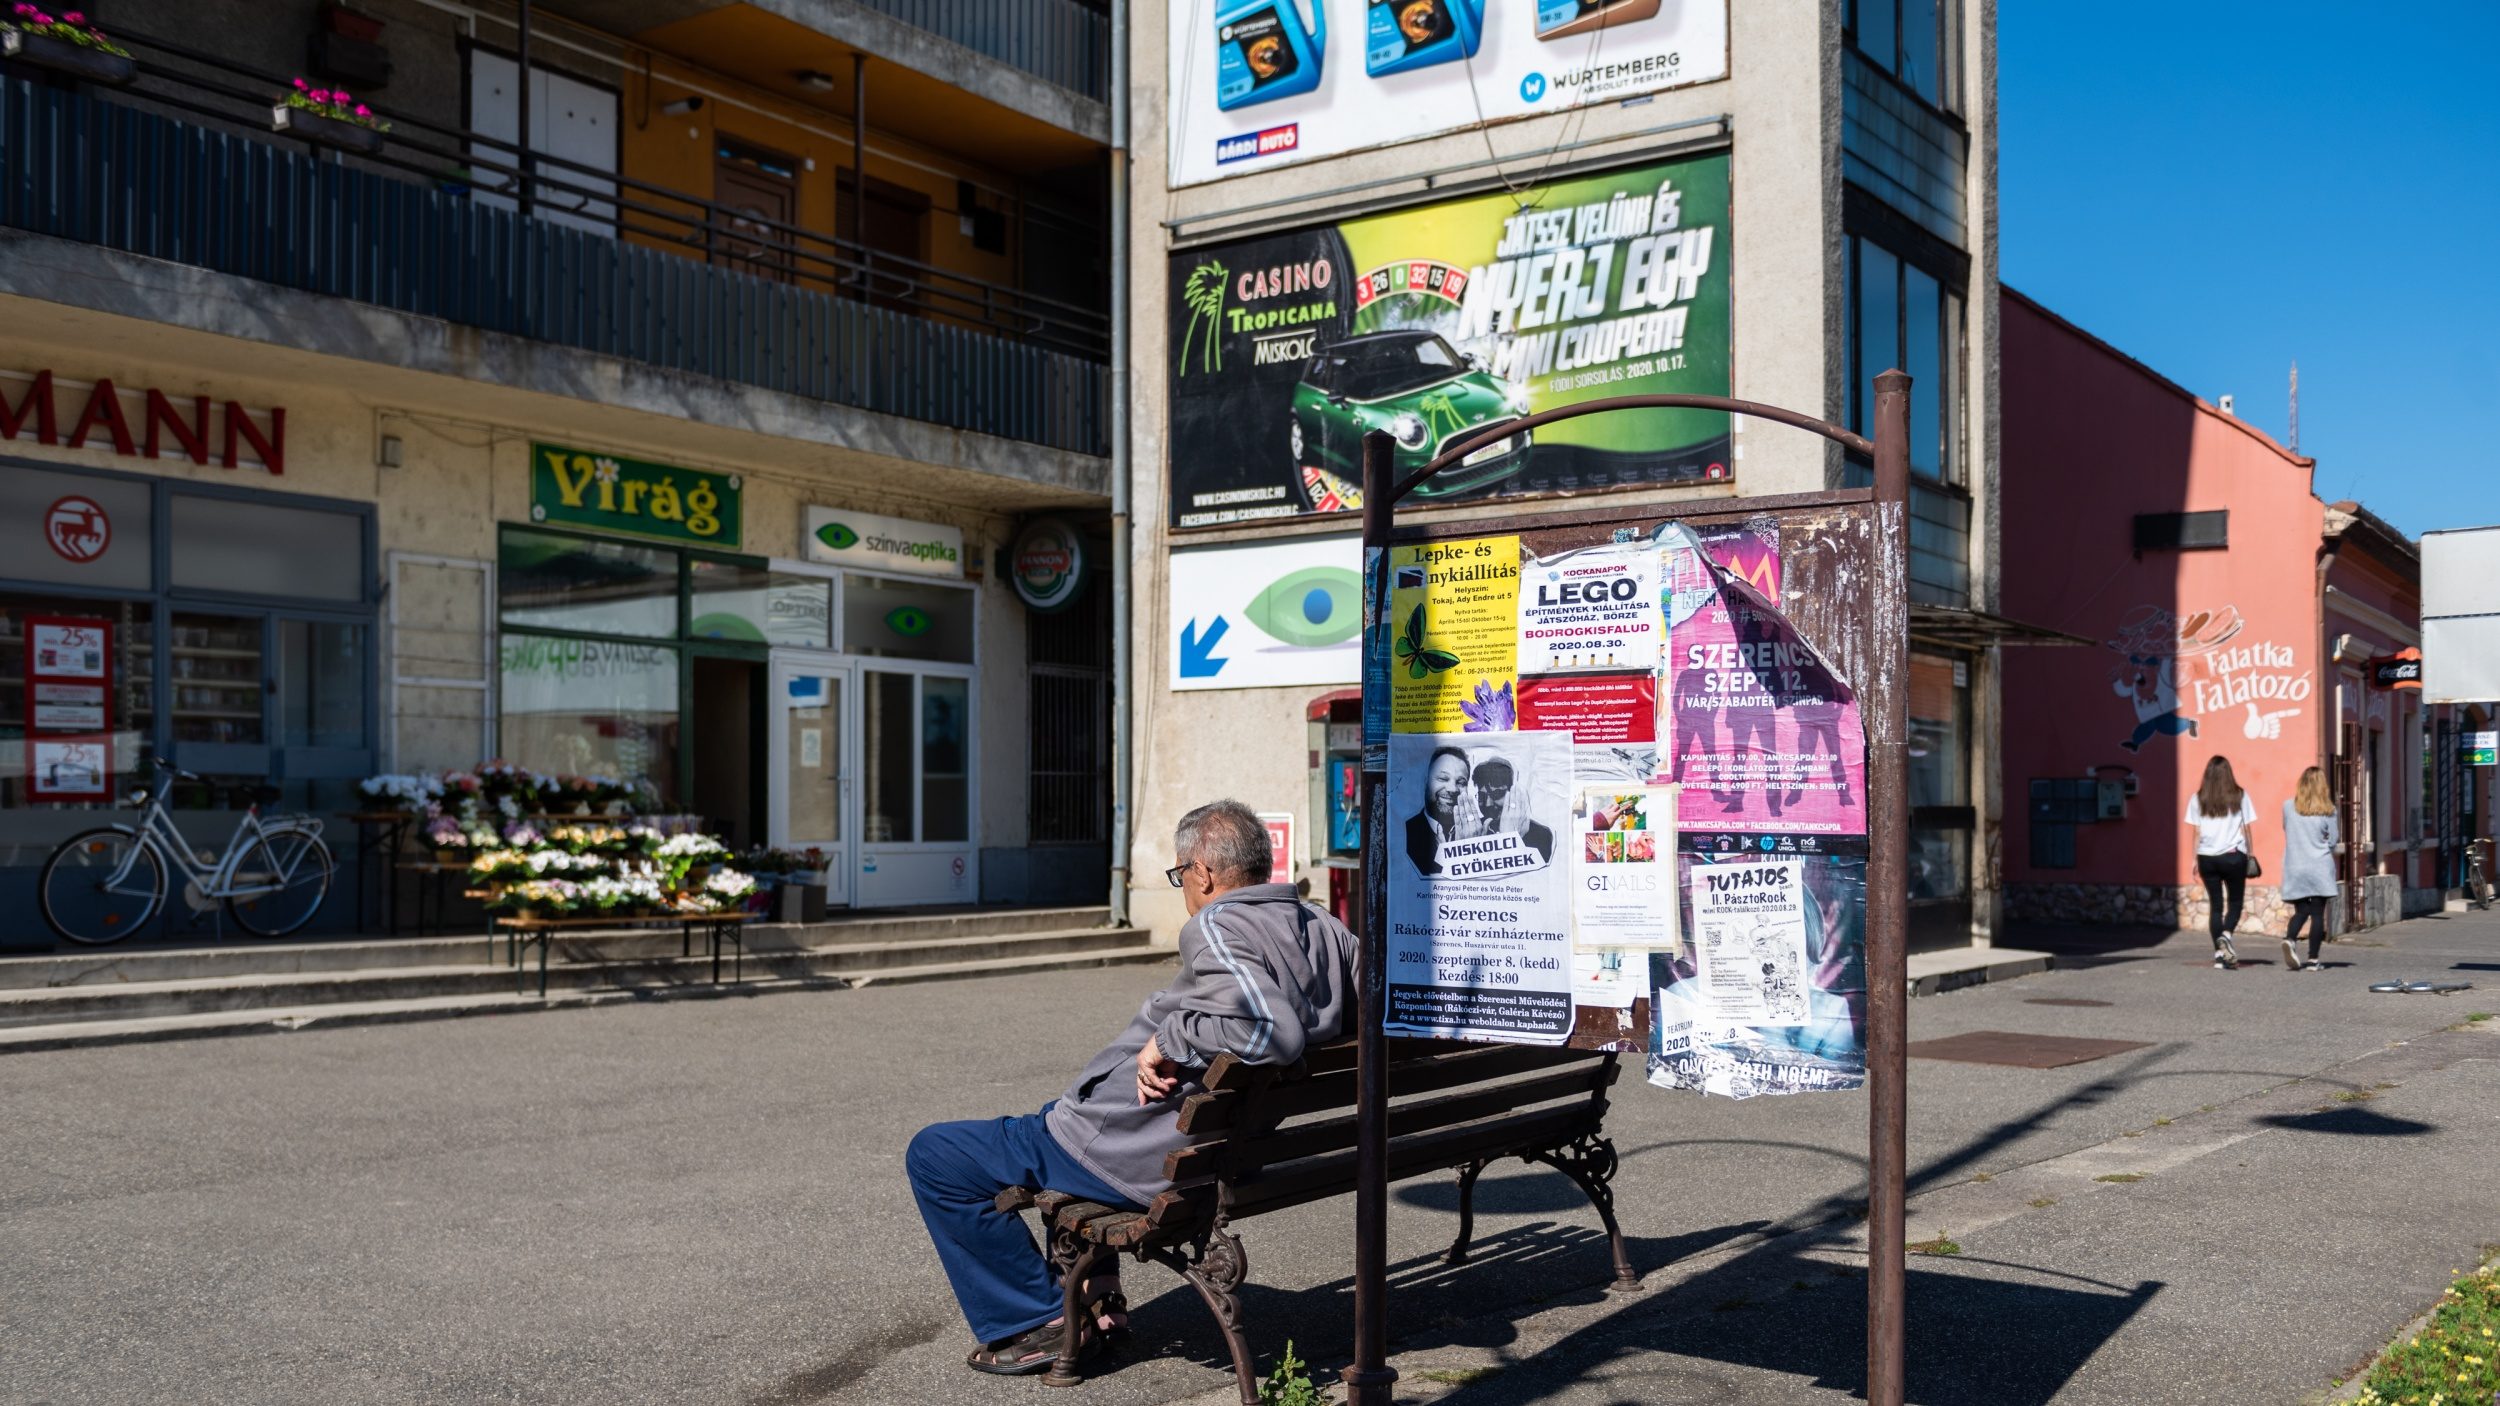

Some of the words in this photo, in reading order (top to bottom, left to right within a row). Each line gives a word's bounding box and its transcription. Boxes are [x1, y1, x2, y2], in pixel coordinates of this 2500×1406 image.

[1553, 53, 1680, 89] WÜRTEMBERG
[1632, 69, 1680, 86] PERFEKT
[1218, 139, 1258, 161] BÁRDI
[1260, 127, 1296, 151] AUTÓ
[1237, 259, 1332, 302] CASINO
[1359, 281, 1369, 299] 3
[1372, 272, 1389, 291] 26
[1396, 267, 1404, 285] 0
[1410, 265, 1428, 284] 32
[1429, 269, 1446, 288] 15
[1446, 273, 1463, 294] 19
[1455, 243, 1615, 342] NYERJ
[1619, 226, 1714, 311] EGY
[1254, 336, 1316, 366] MISKOLC
[1627, 355, 1687, 379] 2020.10.17.
[544, 451, 721, 537] Virág
[1414, 544, 1470, 565] Lepke-
[1474, 542, 1492, 557] és
[1426, 564, 1517, 588] nykiállítás
[1563, 565, 1628, 577] KOCKANAPOK
[1432, 597, 1455, 605] Tokaj,
[1456, 595, 1470, 604] Ady
[1472, 594, 1495, 603] Endre
[1538, 578, 1638, 607] LEGO
[1525, 606, 1590, 617] ÉPÍTMÉNYEK
[1592, 601, 1650, 612] KIÁLLÍTÁSA
[1525, 623, 1650, 639] BODROGKISFALUD
[1549, 639, 1627, 651] 2020.08.30.
[1688, 642, 1816, 670] SZERENCS
[2206, 640, 2294, 677] Falatka
[1704, 671, 1774, 692] SZEPT.
[1780, 670, 1808, 691] 12.
[2192, 671, 2313, 715] Falatozó
[1443, 837, 1518, 859] MISKOLCI
[1451, 853, 1536, 876] GYÖKEREK
[1432, 884, 1461, 894] Aranyosi
[1490, 885, 1505, 893] Vida
[1707, 866, 1789, 893] TUTAJOS
[1723, 891, 1788, 906] PásztoRock
[1438, 904, 1519, 923] Szerencs
[1394, 923, 1473, 938] Rákóczi-vár
[1474, 927, 1565, 942] színházterme
[1398, 951, 1430, 964] 2020.
[1431, 953, 1503, 968] szeptember
[1505, 956, 1517, 968] 8.
[1519, 956, 1561, 971] (kedd)
[1438, 969, 1486, 983] Kezdés:
[1488, 971, 1520, 984] 18:00
[1393, 989, 1422, 1001] Jegyek
[1423, 991, 1469, 1002] elővételben
[1477, 993, 1518, 1005] Szerencsi
[1394, 1000, 1443, 1013] Központban
[1498, 1006, 1531, 1018] Galéria
[1416, 1013, 1468, 1024] www.tixa.hu
[1468, 1016, 1516, 1028] weboldalon
[1516, 1018, 1560, 1031] kaphatók.
[1666, 1035, 1691, 1051] 2020
